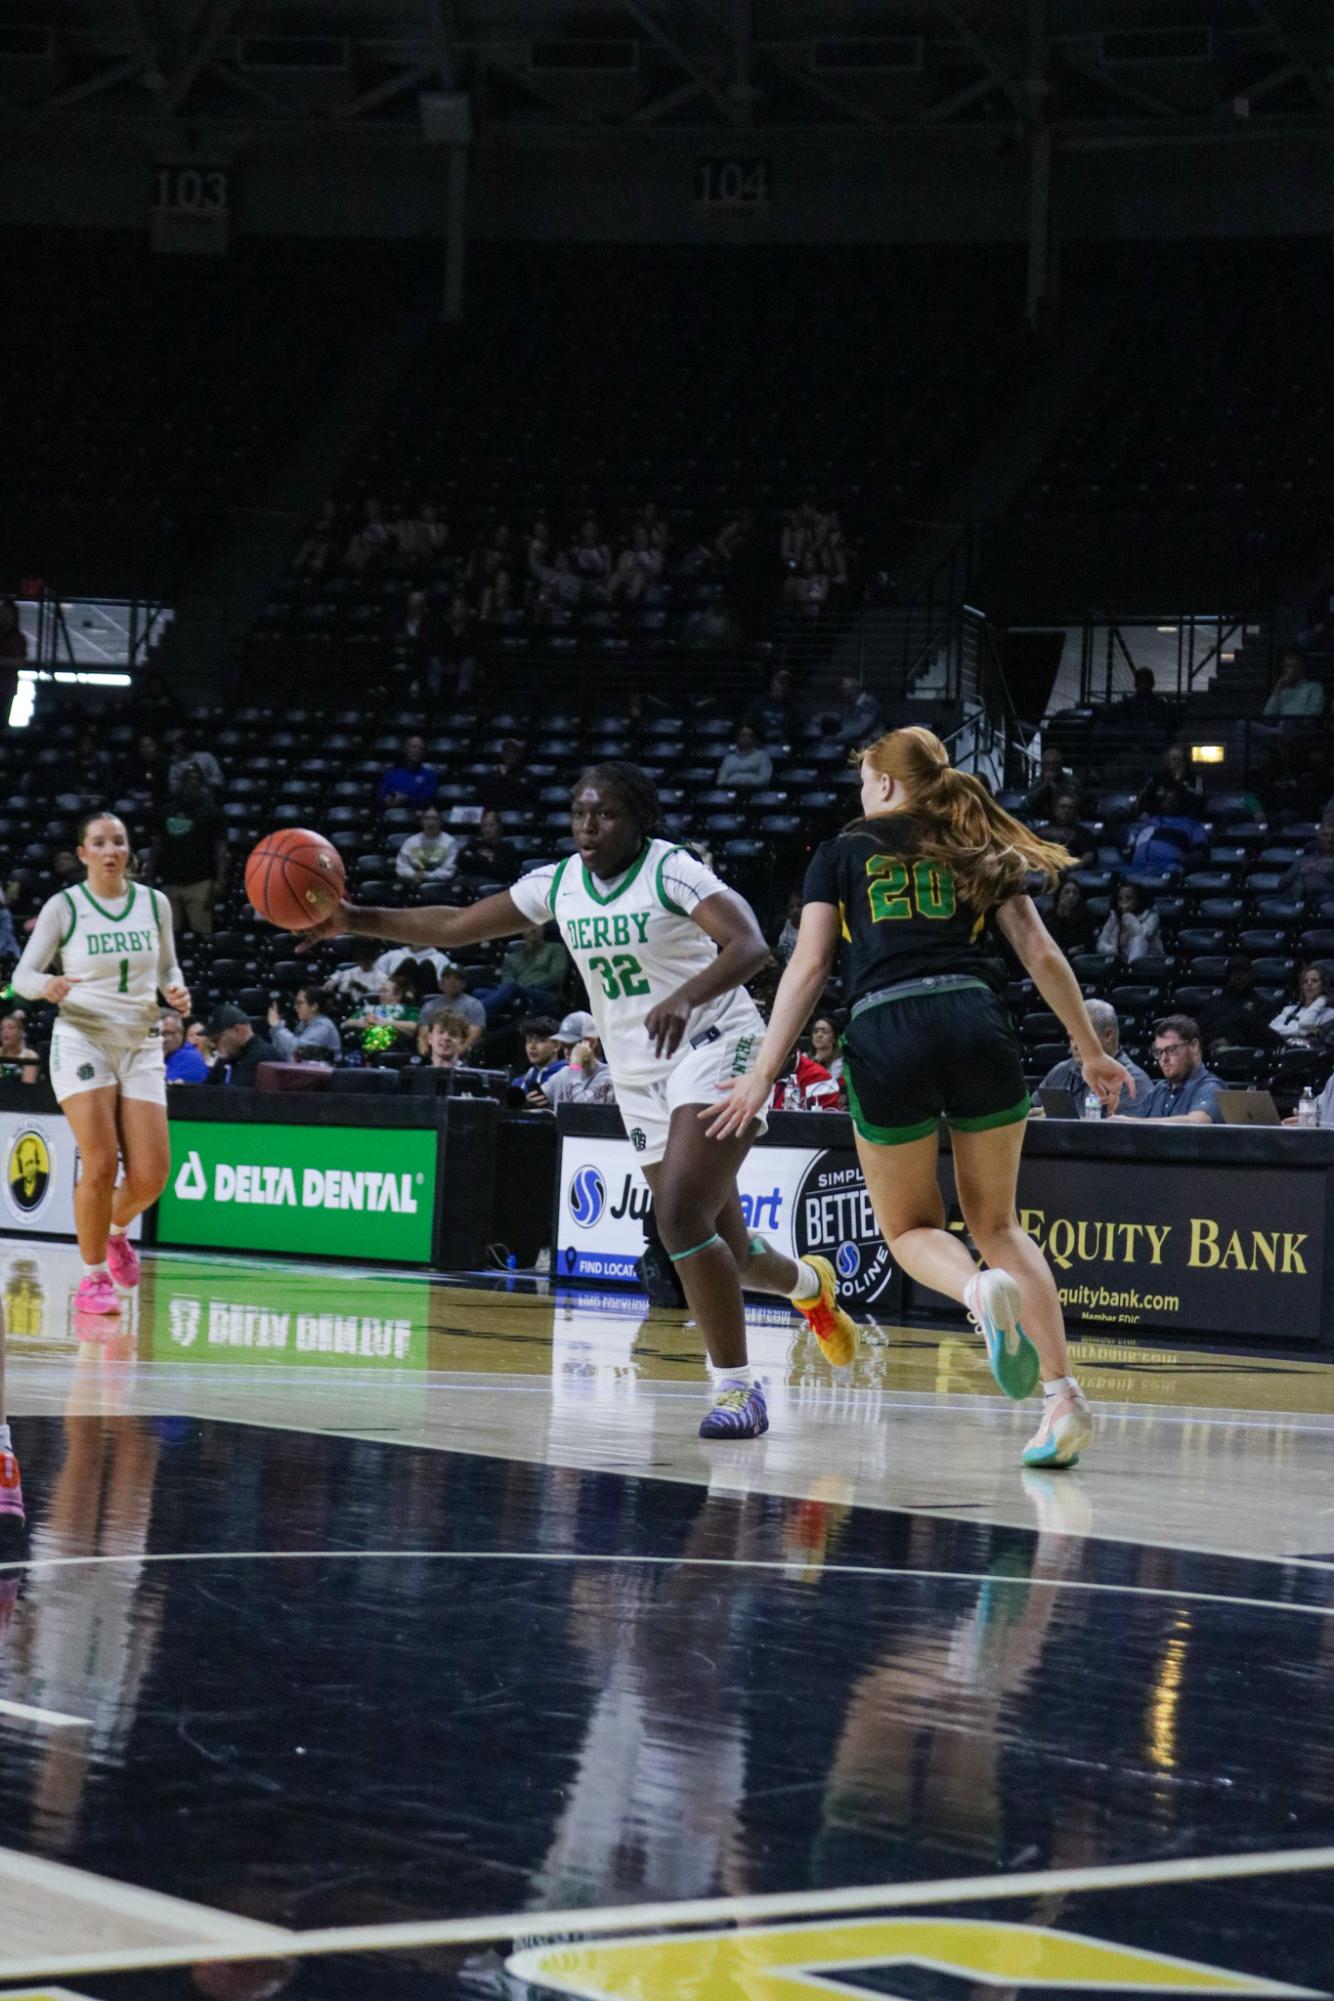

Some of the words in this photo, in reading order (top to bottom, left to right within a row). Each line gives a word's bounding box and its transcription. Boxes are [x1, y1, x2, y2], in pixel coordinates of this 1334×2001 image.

[158, 169, 227, 208] 103
[700, 163, 768, 203] 104
[866, 854, 957, 923] 20
[86, 930, 152, 956] DERBY
[567, 912, 651, 949] DERBY
[118, 958, 129, 993] 1
[588, 953, 651, 1000] 32
[214, 1163, 298, 1207] DELTA
[302, 1168, 418, 1214] DENTAL
[818, 1167, 865, 1188] SIMPL
[805, 1189, 881, 1247] BETTE
[1187, 1217, 1308, 1275] BANK
[579, 1260, 602, 1275] FIND
[603, 1262, 637, 1278] LOCAT
[834, 1245, 889, 1297] OLINE
[1058, 1285, 1180, 1311] quitybank.com
[1081, 1311, 1117, 1323] Member
